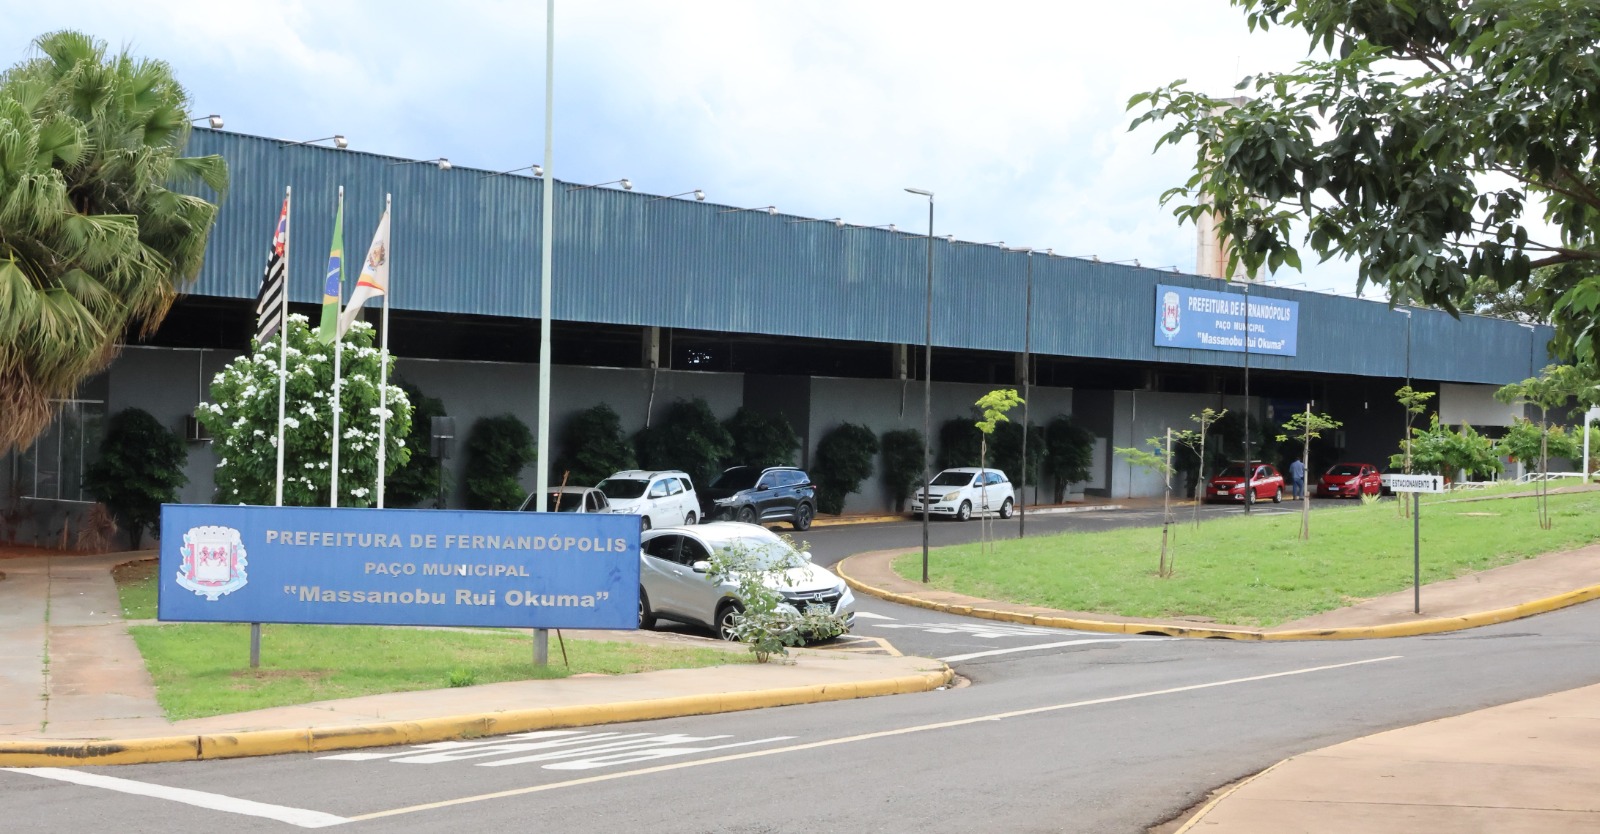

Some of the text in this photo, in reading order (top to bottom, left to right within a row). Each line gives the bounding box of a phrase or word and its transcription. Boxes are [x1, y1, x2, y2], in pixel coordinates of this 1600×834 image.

[1188, 296, 1229, 314] PREFEITURA
[1230, 301, 1239, 315] DE
[1215, 320, 1231, 331] PAÇO
[1392, 479, 1430, 489] ESTACIONAMENTO
[266, 530, 627, 552] PREFEITURA DE FERNANDÓPOLIS
[364, 562, 530, 578] PAÇO MUNICIPAL
[283, 585, 609, 608] “Massanobu Rui Okuma”
